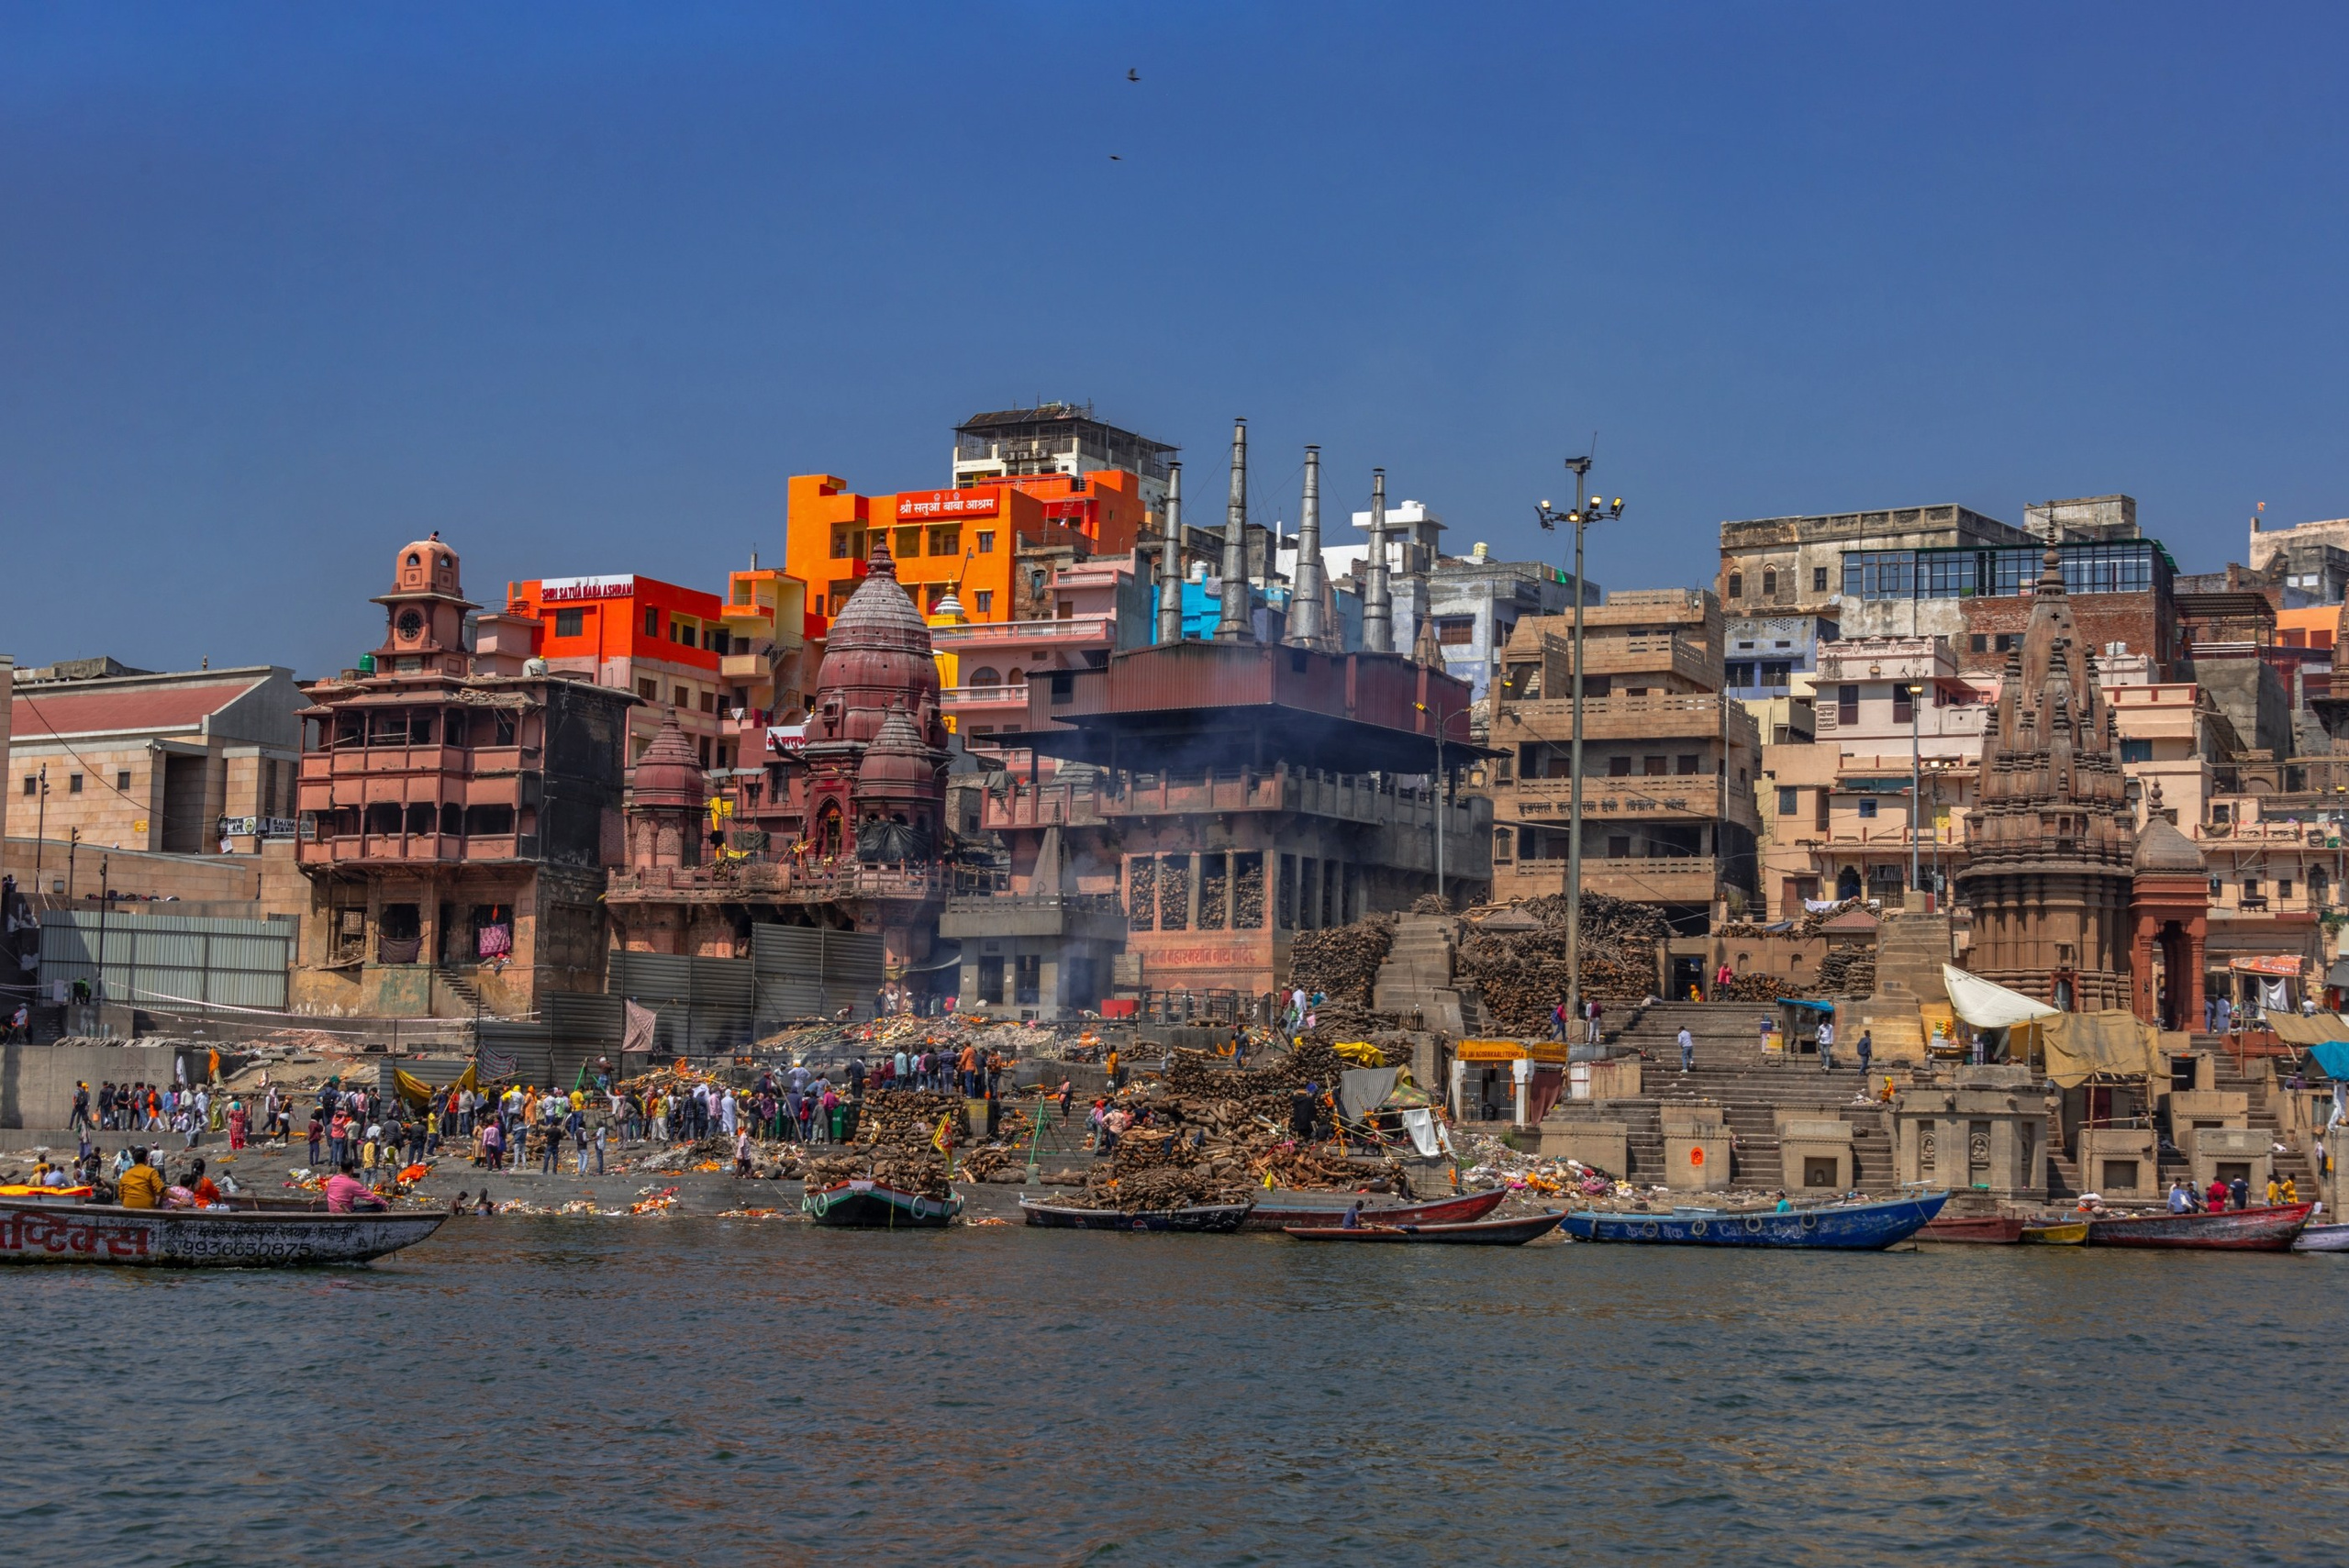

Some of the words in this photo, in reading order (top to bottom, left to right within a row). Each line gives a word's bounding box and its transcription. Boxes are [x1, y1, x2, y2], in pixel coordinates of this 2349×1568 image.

[899, 499, 912, 515] श्री
[943, 500, 964, 511] बाबा
[966, 498, 995, 510] आश्रम
[541, 587, 558, 601] SHRI
[558, 585, 583, 599] SATUA
[583, 584, 602, 597] BABA
[602, 583, 633, 596] ASHRAM
[273, 818, 296, 828] SHIVA
